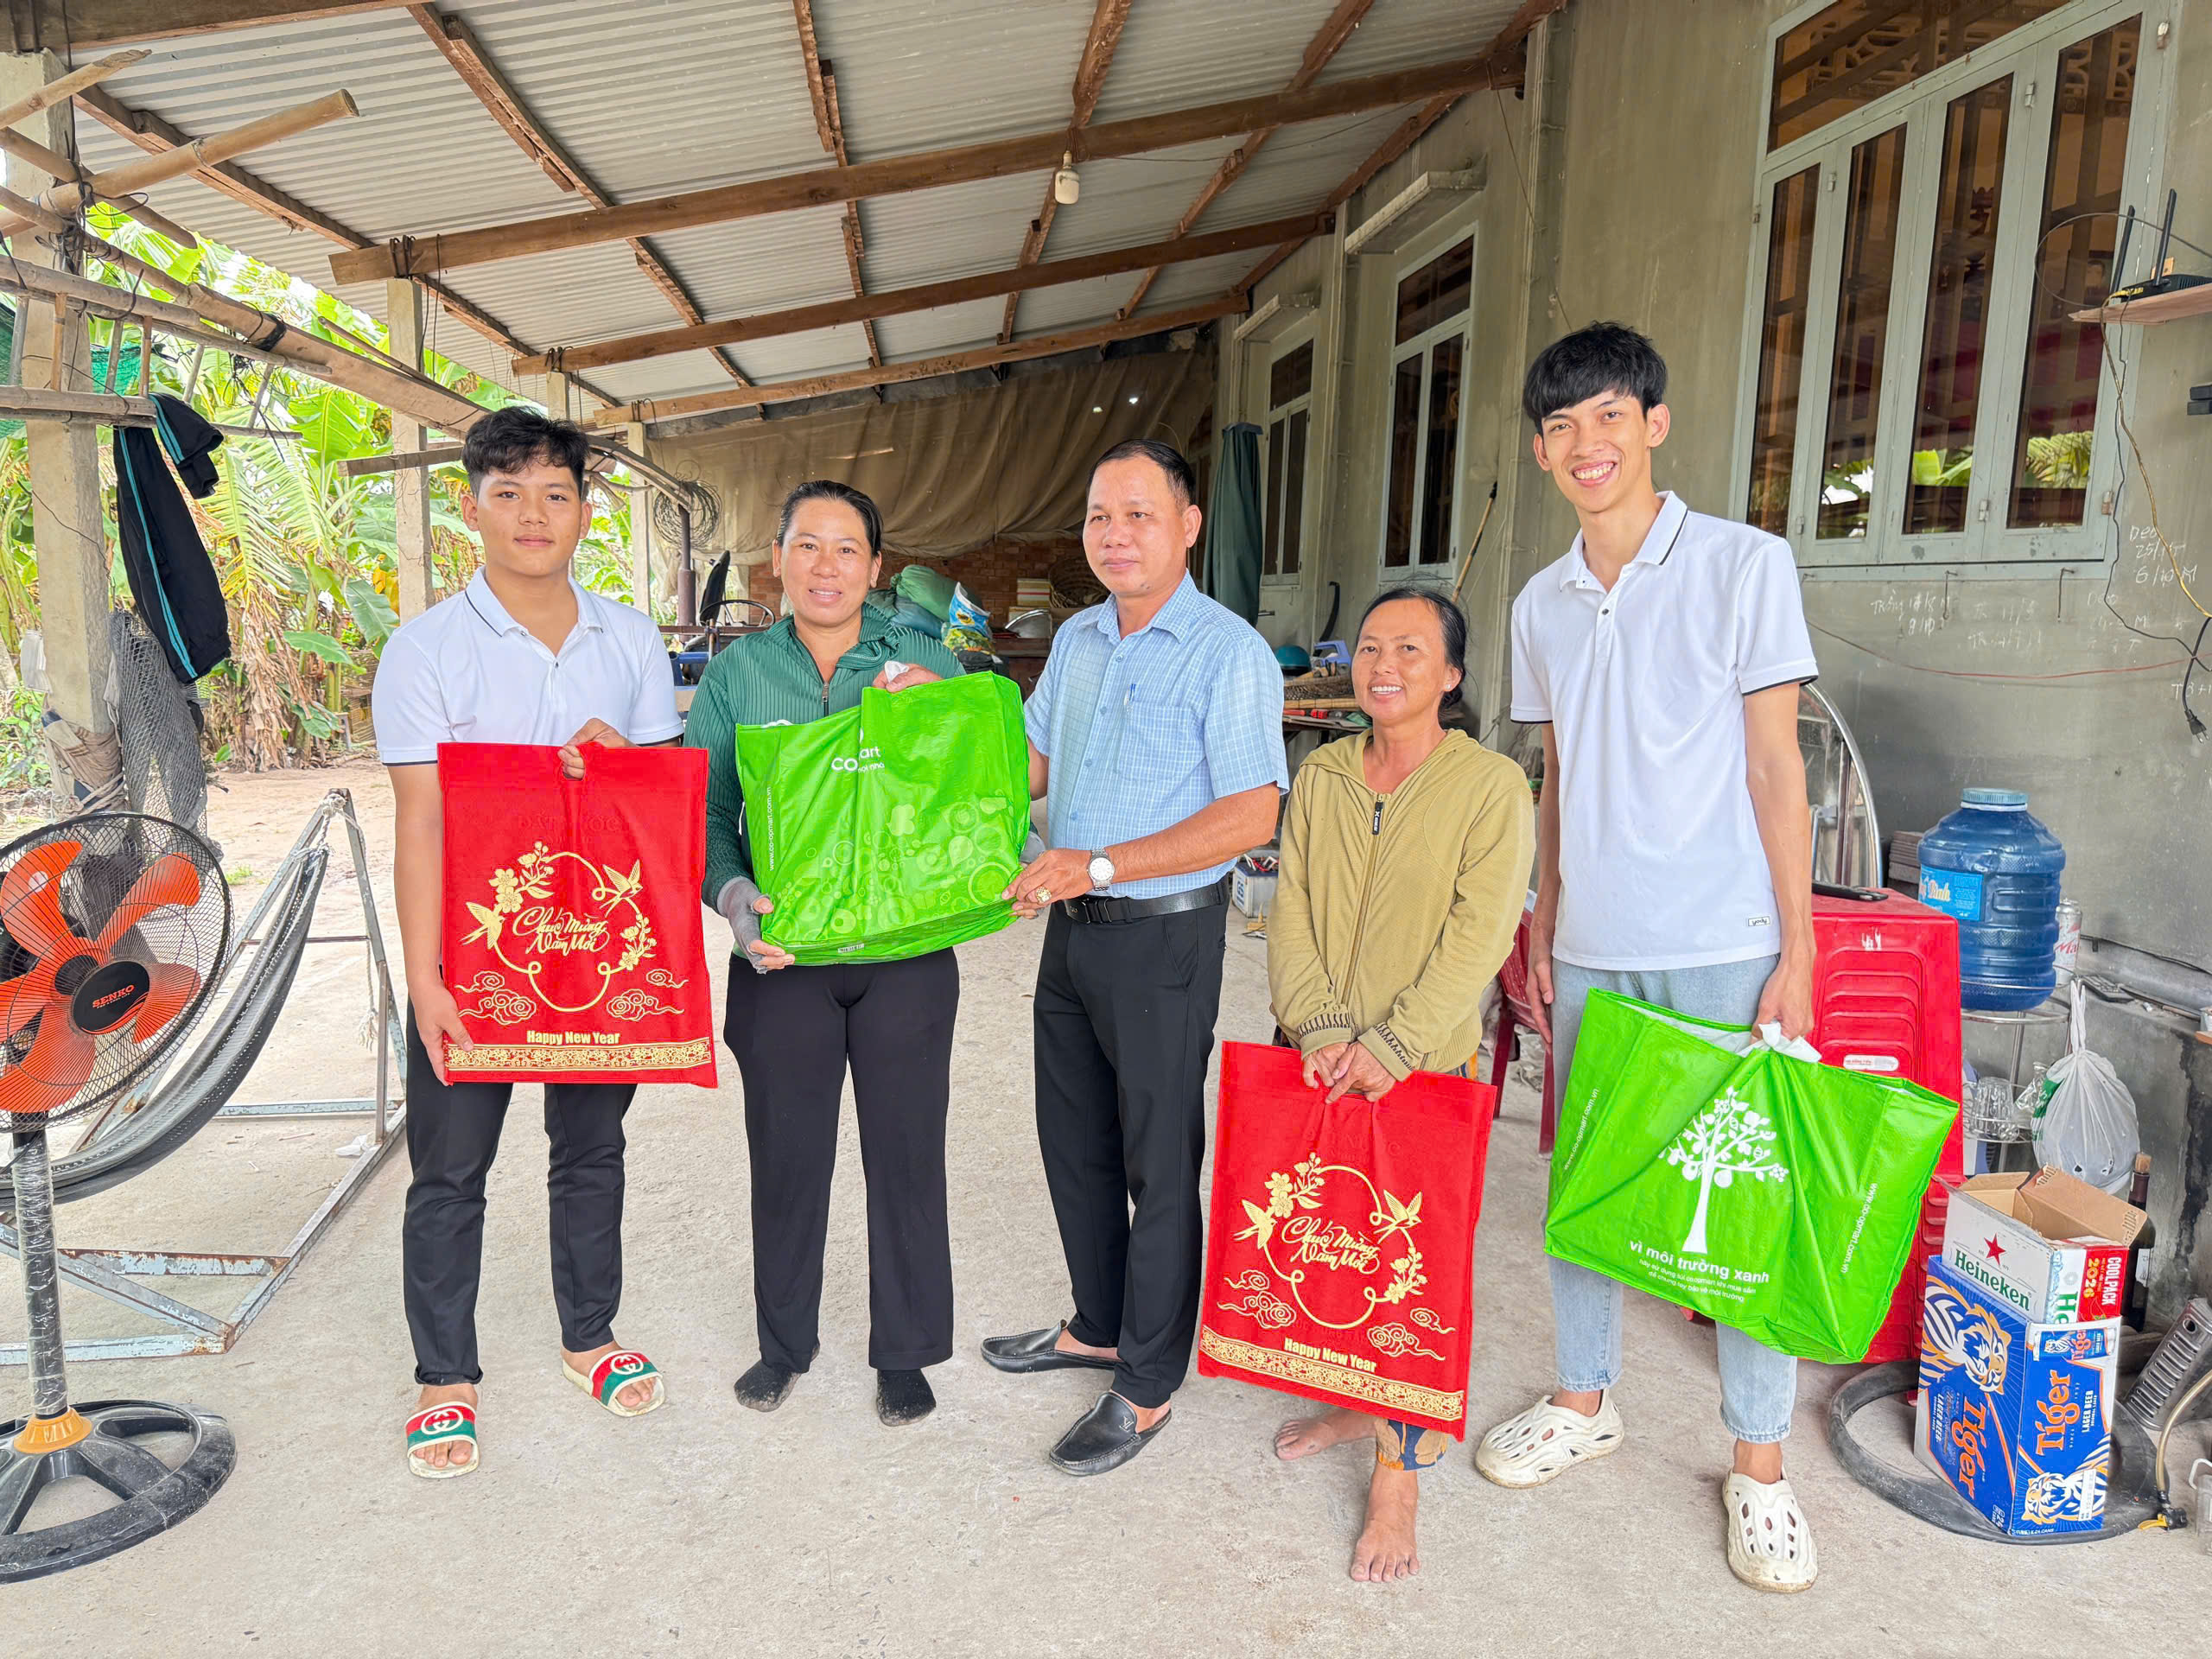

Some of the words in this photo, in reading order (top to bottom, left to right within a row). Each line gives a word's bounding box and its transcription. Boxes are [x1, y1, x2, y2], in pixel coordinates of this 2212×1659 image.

[766, 787, 775, 872] www.co-opmart.com.vn
[92, 984, 135, 1008] SENKO
[526, 1030, 563, 1046] Happy
[565, 1031, 591, 1045] New
[593, 1032, 620, 1045] Year
[1630, 1240, 1643, 1253] vì
[1646, 1247, 1674, 1265] môi
[1677, 1256, 1729, 1279] trường
[1734, 1268, 1770, 1283] xanh
[1955, 1249, 2030, 1312] Heineken
[2083, 1258, 2100, 1298] 2026
[2101, 1256, 2121, 1306] COOLPACK
[1284, 1337, 1321, 1360] Happy
[1322, 1347, 1348, 1366] New
[1350, 1354, 1377, 1373] Year
[2035, 1370, 2081, 1457] Tiger
[2084, 1389, 2094, 1409] BEER
[2082, 1409, 2091, 1433] LAGER
[1951, 1395, 1986, 1500] Tiger
